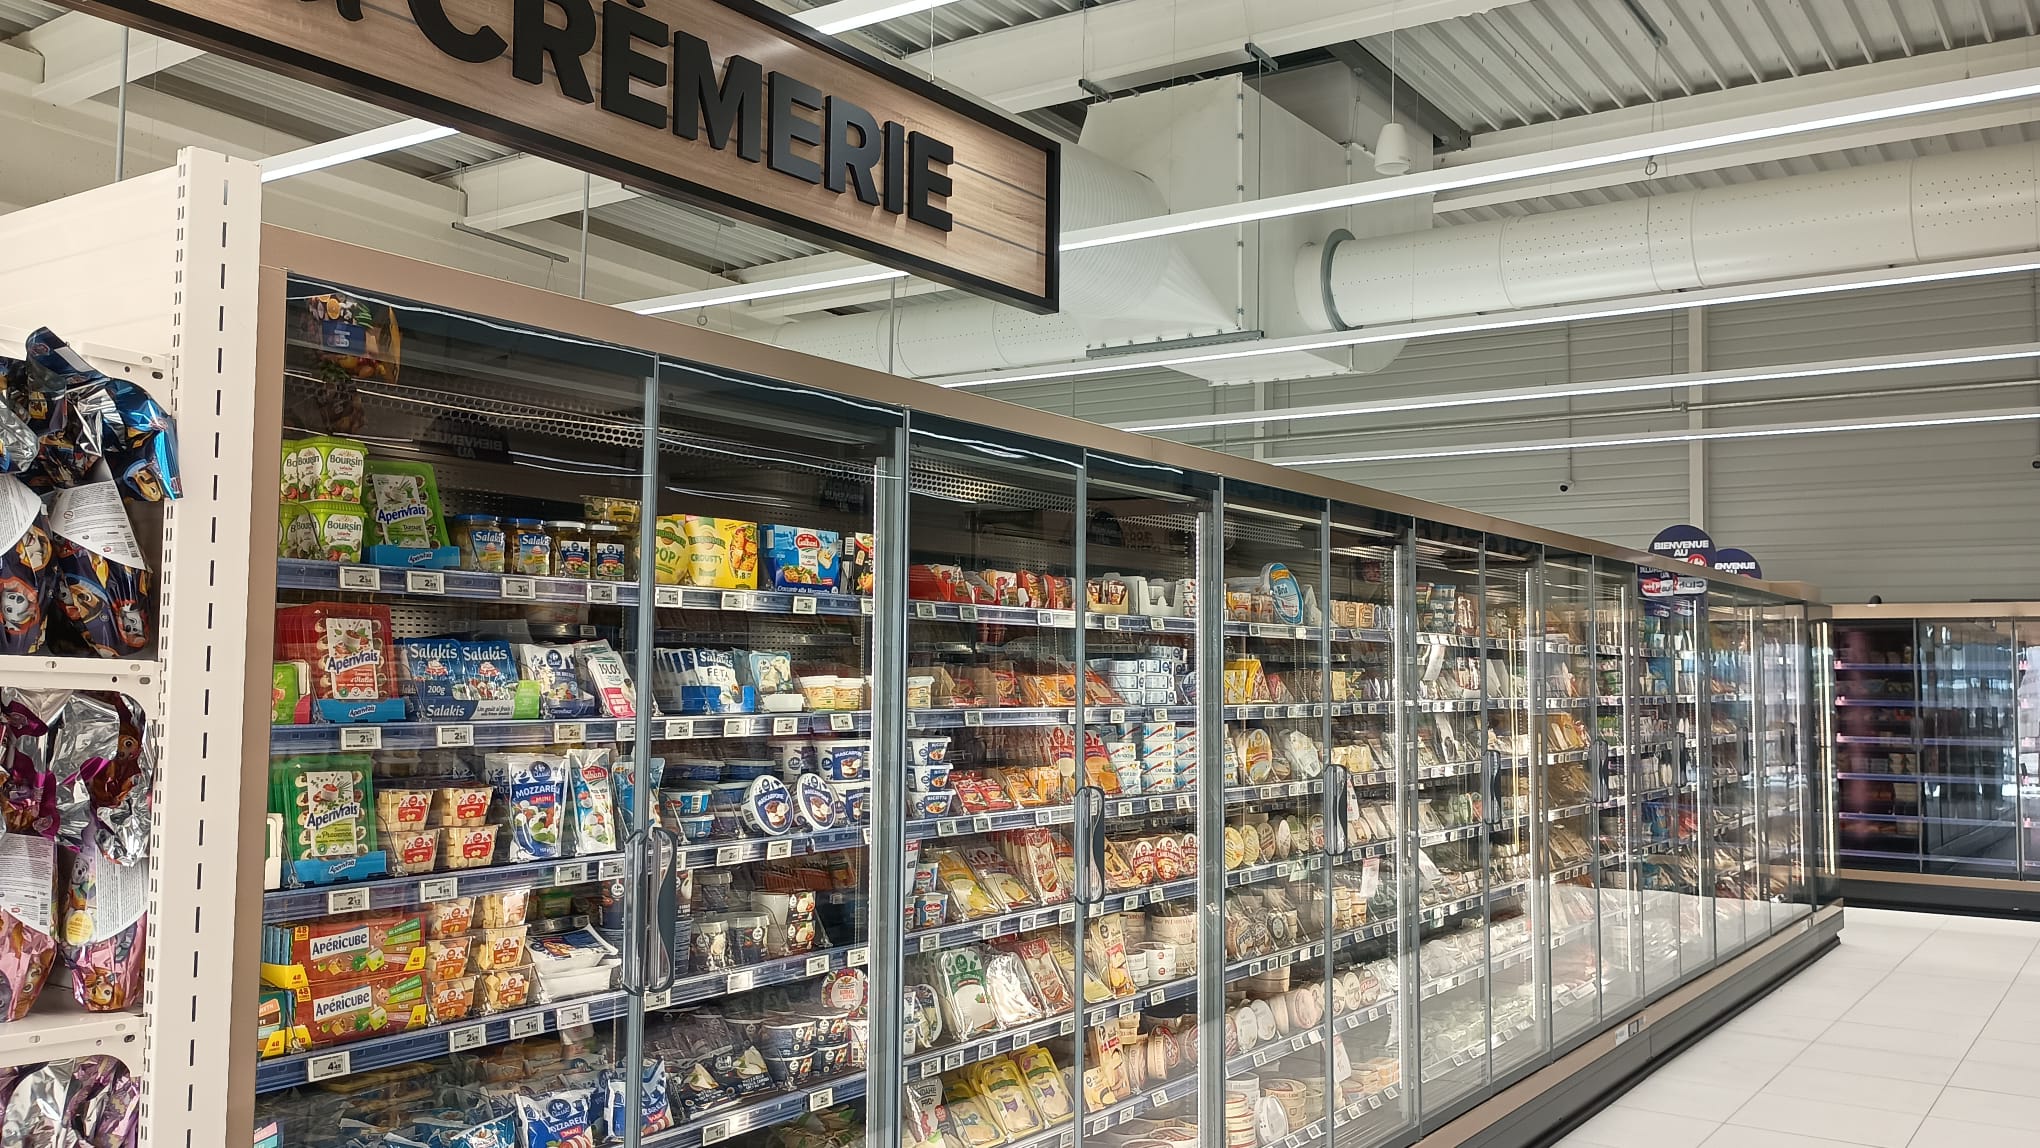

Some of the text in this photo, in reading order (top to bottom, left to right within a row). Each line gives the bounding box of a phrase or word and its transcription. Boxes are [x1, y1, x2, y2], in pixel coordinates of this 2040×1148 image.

[329, 454, 363, 467] Boursin
[327, 520, 362, 531] Boursin
[1653, 540, 1709, 550] BIENVENUE
[1673, 549, 1689, 557] AU
[409, 643, 458, 659] Salakis
[462, 646, 508, 661] Salakis
[427, 685, 446, 696] 200g
[426, 704, 465, 717] Salakis
[296, 926, 308, 934] 48
[311, 932, 368, 956] Apéricube
[298, 987, 309, 995] 48
[315, 992, 370, 1017] Apéricube
